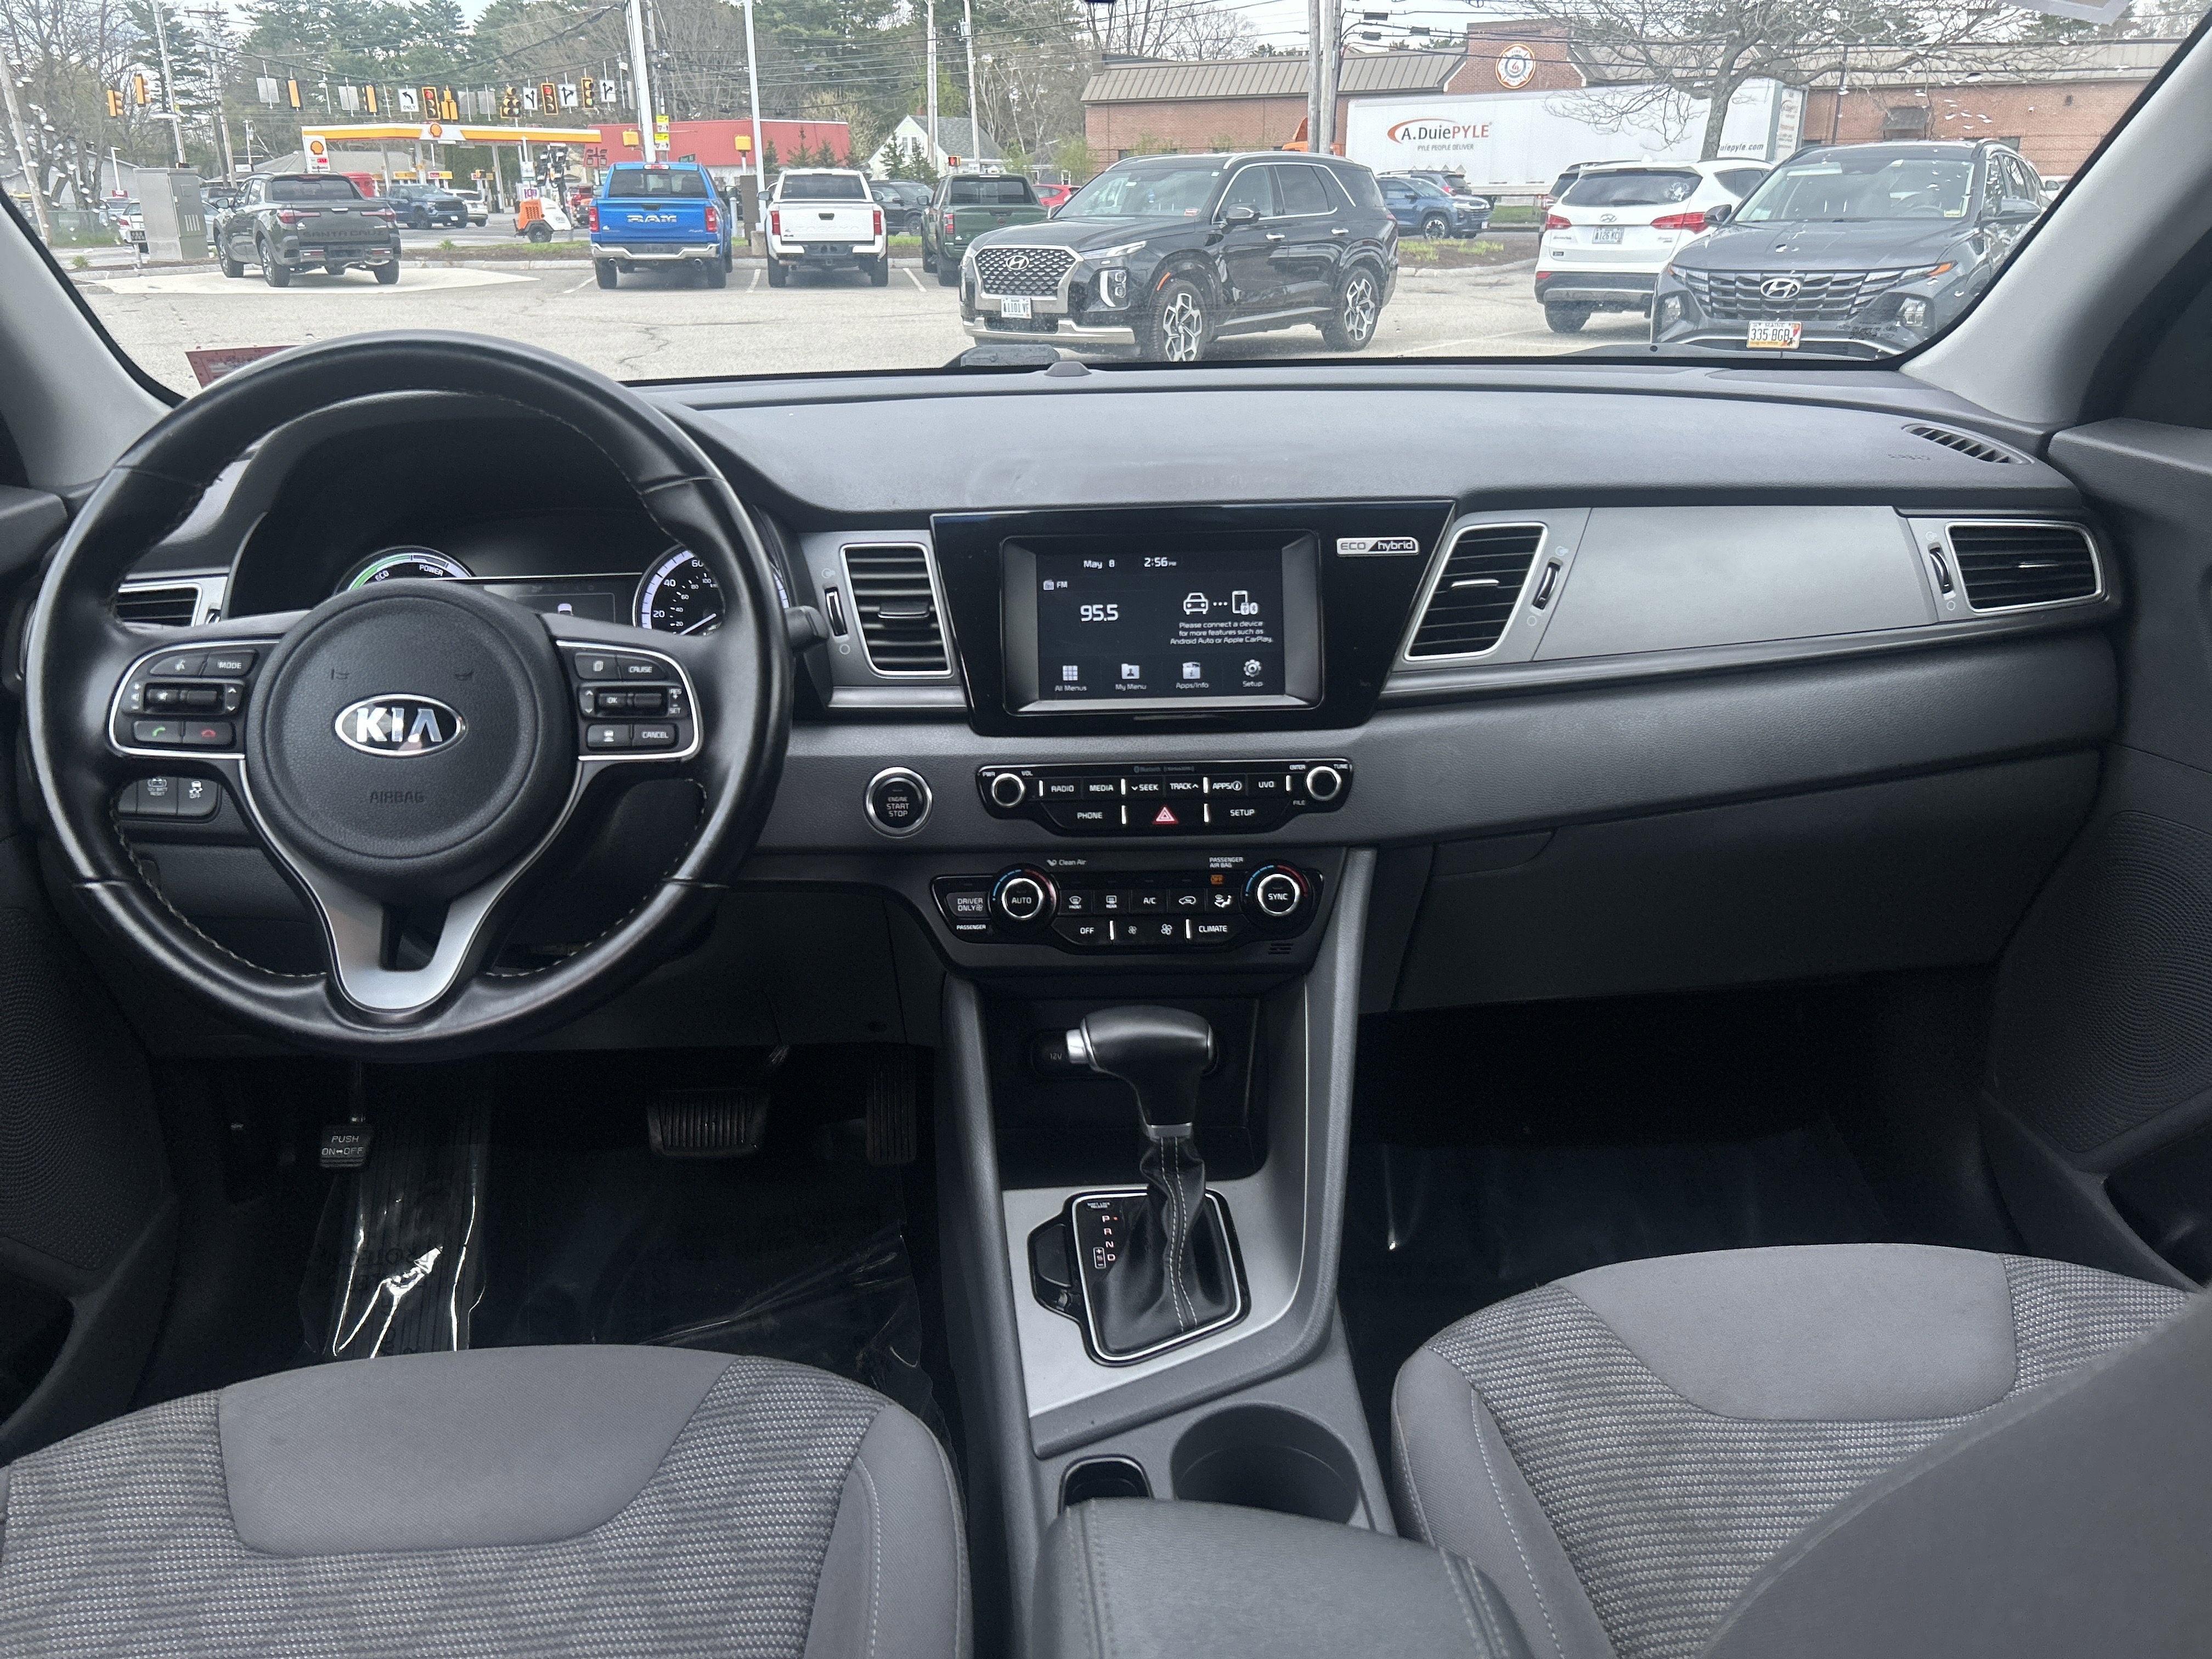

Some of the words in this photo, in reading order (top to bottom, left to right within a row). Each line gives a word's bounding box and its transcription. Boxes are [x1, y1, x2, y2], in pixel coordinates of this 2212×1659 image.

[1719, 143, 1764, 153] uiepyle.com
[626, 215, 678, 223] RAM
[1751, 328, 1769, 341] 335
[1340, 542, 1366, 550] ECO
[1378, 540, 1413, 552] hybrid
[1083, 560, 1103, 569] May
[1109, 559, 1115, 568] 8
[1144, 557, 1168, 567] 2:56
[419, 564, 444, 577] POWER
[375, 569, 390, 582] ECO
[1057, 580, 1068, 589] FM
[1080, 604, 1119, 622] 95.5
[357, 707, 443, 743] KIA
[1051, 785, 1075, 793] RADIO
[1089, 784, 1114, 792] MEDIA
[1138, 783, 1159, 791] SEEK
[369, 791, 425, 804] AIRBAG
[1076, 811, 1103, 820] PHONE
[1211, 876, 1223, 884] OFF
[1011, 896, 1032, 905] AUTO
[1267, 893, 1289, 901] SYNC
[1198, 925, 1228, 933] CLIMATE
[343, 1147, 364, 1155] OFF
